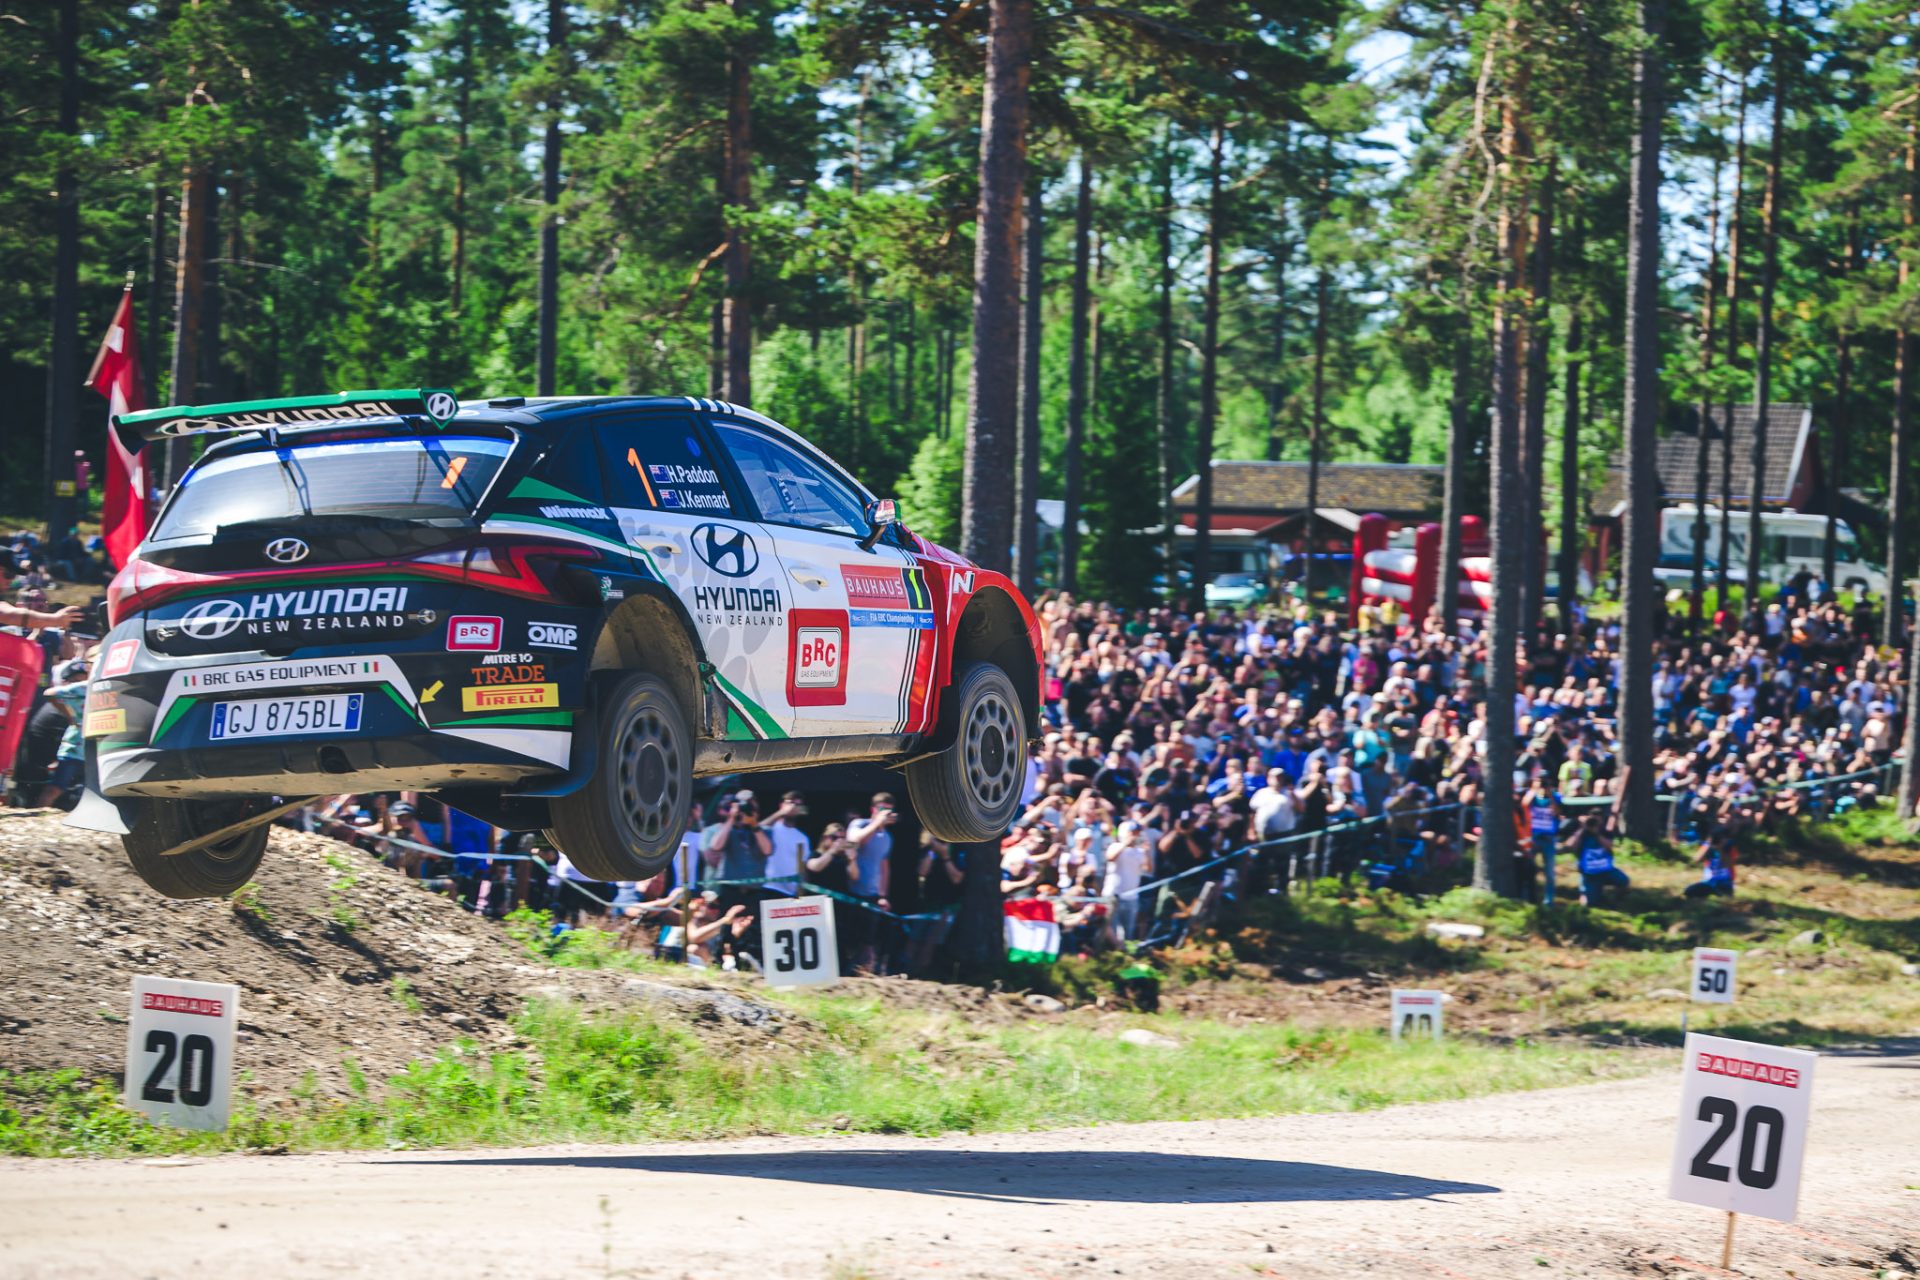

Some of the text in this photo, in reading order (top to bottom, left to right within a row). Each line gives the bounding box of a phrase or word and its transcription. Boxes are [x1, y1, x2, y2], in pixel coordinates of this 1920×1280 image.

[230, 401, 397, 427] HYUNDAI
[440, 456, 468, 489] 1
[627, 447, 658, 507] 1
[668, 463, 719, 484] H.Paddon
[679, 490, 731, 509] J.Kennard
[846, 577, 904, 595] BAUHAUS
[250, 587, 408, 619] HYUNDAI
[694, 586, 782, 612] HYUNDAI
[248, 615, 404, 634] NEW ZEALAND
[460, 626, 489, 637] BRC
[698, 614, 783, 626] NEW ZEALAND
[528, 626, 578, 645] OMP
[482, 653, 533, 665] MITRE 10
[801, 638, 836, 668] BRC
[203, 663, 358, 686] BRC GAS EQUIPMENT
[471, 664, 545, 685] TRADE
[476, 688, 545, 706] PIRELLI
[229, 699, 342, 734] GJ 875BL
[775, 927, 819, 972] 30
[1699, 967, 1728, 993] 50
[143, 994, 223, 1015] BAUHAUS
[141, 1030, 214, 1107] 20
[1698, 1053, 1798, 1085] BAUHAUS
[1689, 1096, 1784, 1190] 20
